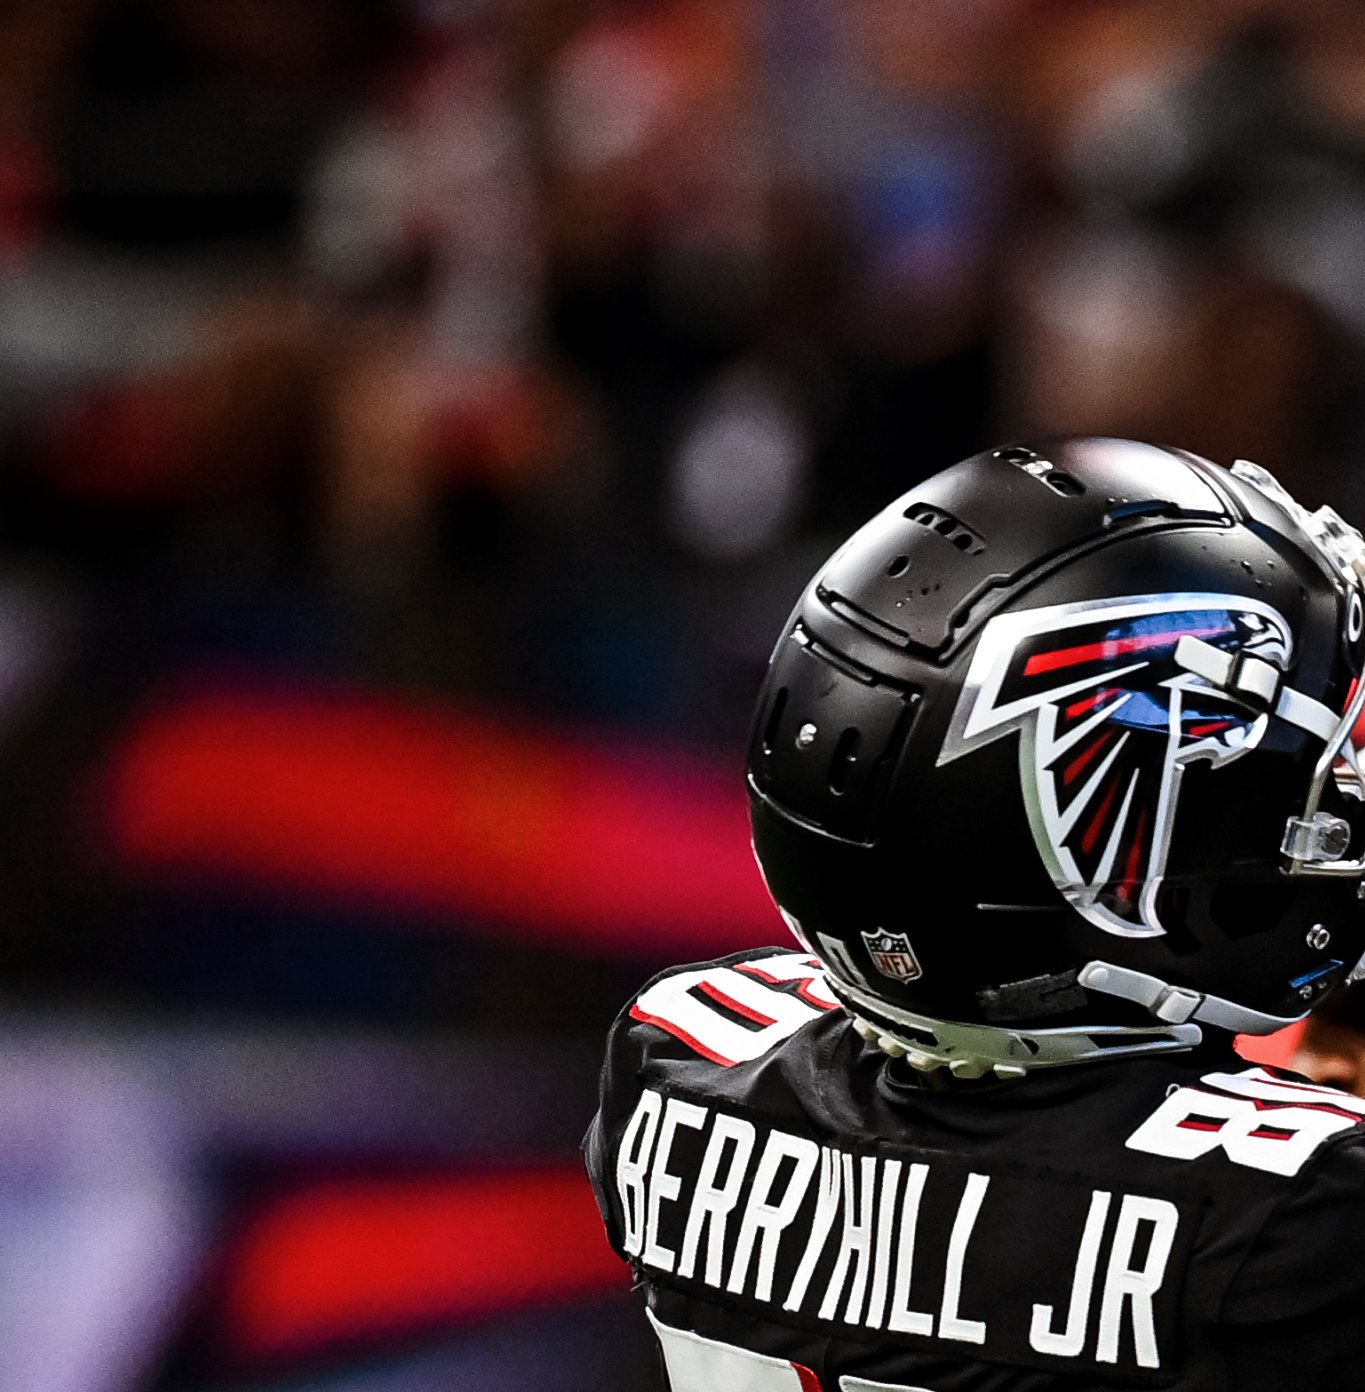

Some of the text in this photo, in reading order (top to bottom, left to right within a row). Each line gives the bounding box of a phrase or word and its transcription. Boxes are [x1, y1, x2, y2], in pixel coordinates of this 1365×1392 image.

[879, 954, 916, 976] NFL
[616, 1088, 1180, 1370] BERRYHILL JR
